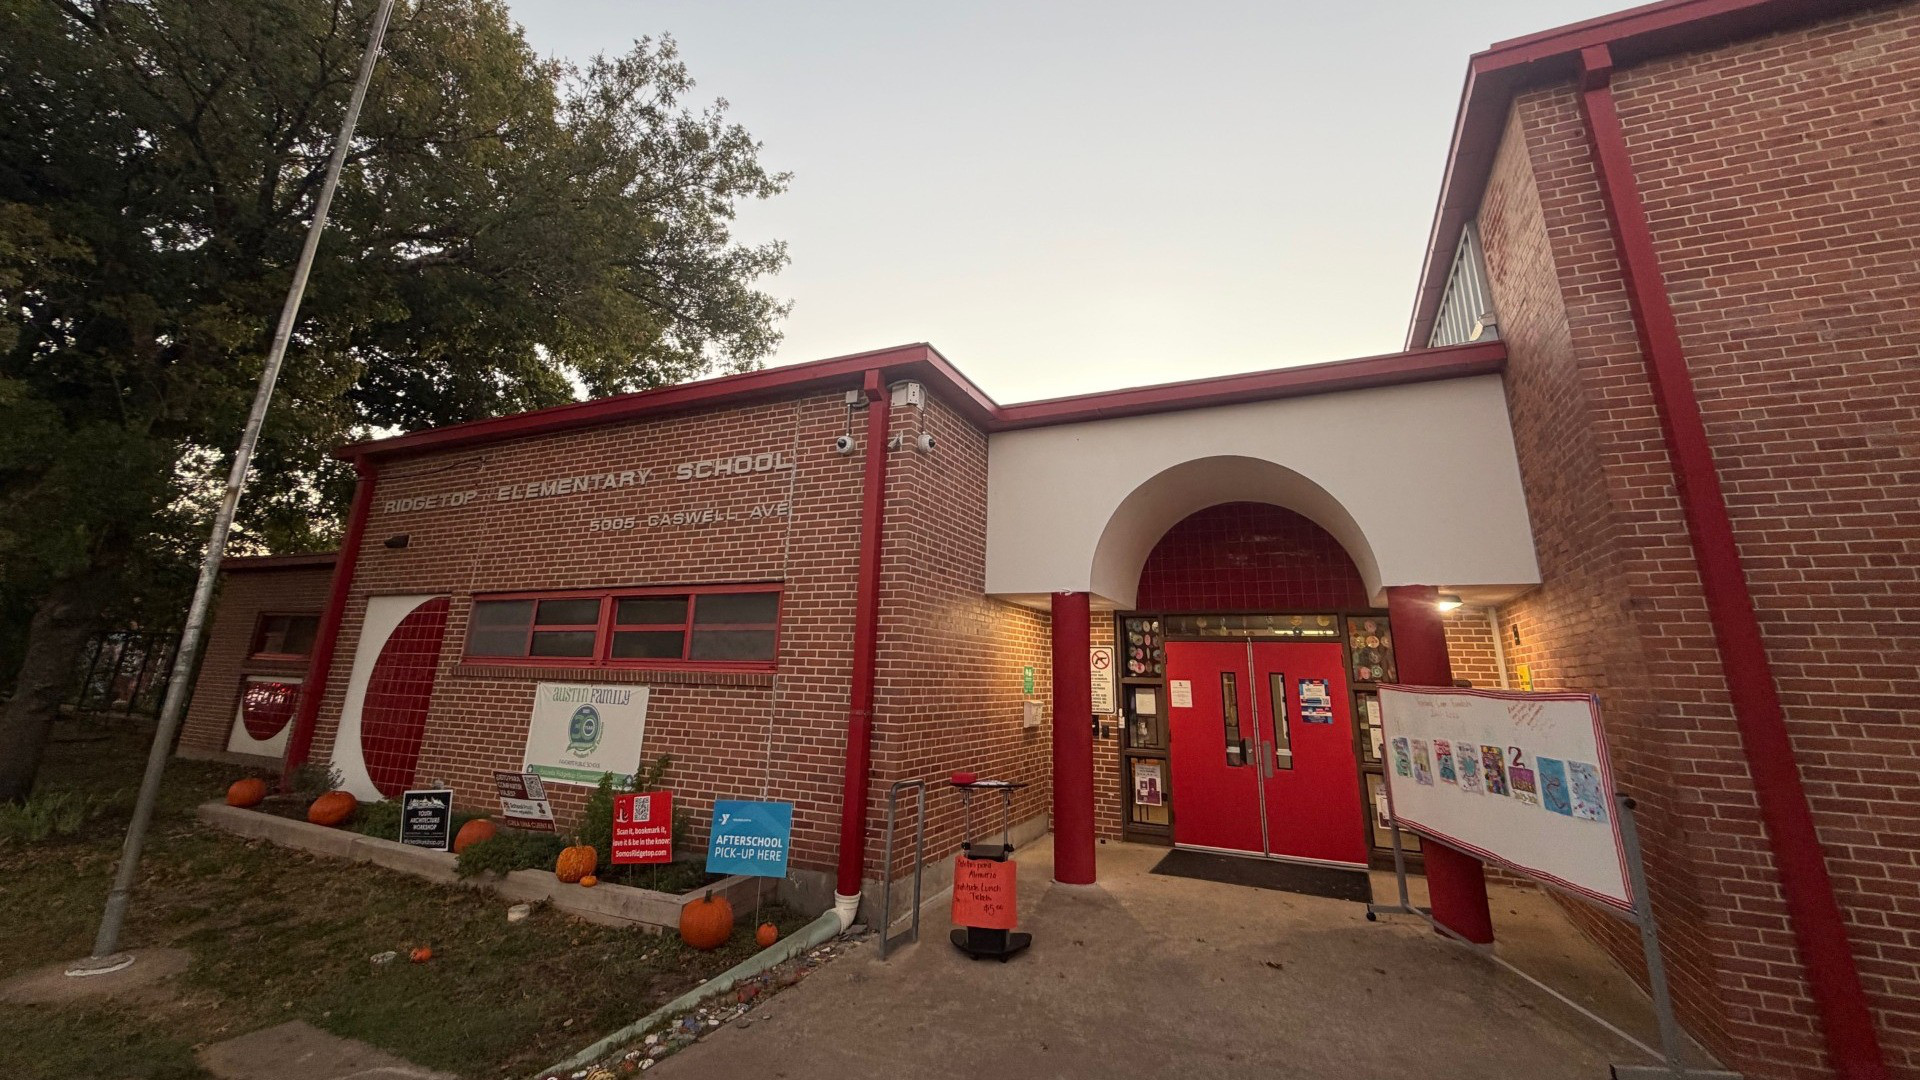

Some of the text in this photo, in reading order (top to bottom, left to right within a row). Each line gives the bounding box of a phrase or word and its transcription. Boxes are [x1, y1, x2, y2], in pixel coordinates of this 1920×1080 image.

[383, 453, 793, 514] RIDGETOP ELEMENTARY SCHOOL
[589, 502, 789, 532] 5005 CASWELL AVE
[635, 826, 660, 834] bookmark
[632, 838, 639, 846] be
[646, 837, 654, 845] the
[716, 835, 783, 848] AFTERSCHOOL
[616, 849, 667, 858] SomosRidgetop.com
[715, 847, 782, 862] PICK-UP HERE
